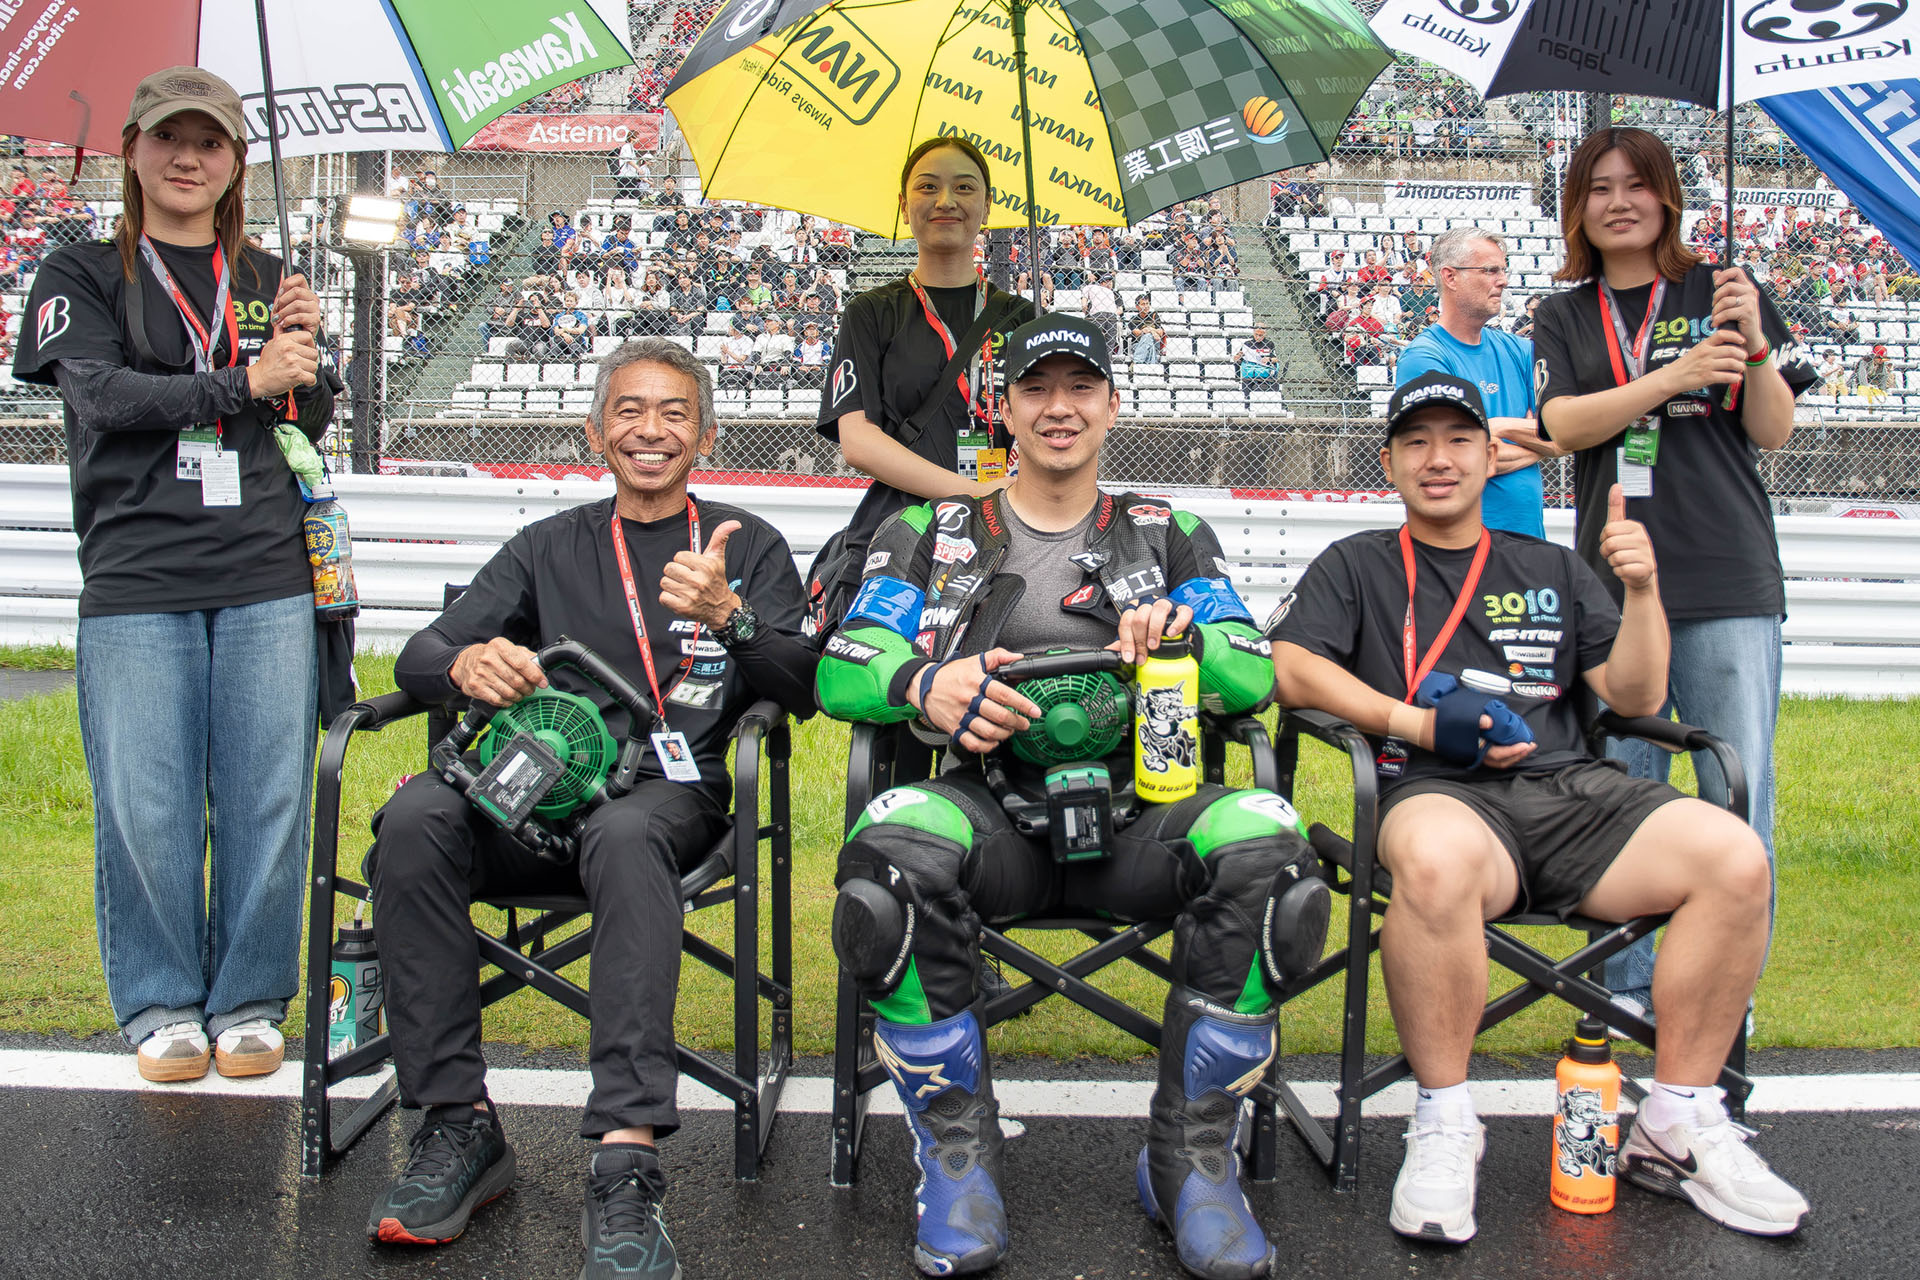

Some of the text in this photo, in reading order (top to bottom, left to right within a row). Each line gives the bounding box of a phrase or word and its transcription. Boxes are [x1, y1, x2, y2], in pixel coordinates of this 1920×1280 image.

[526, 122, 632, 145] Astemo
[1395, 181, 1522, 201] BRIDGESTONE
[1653, 316, 1689, 340] 30
[1025, 329, 1091, 351] NANKAI
[1402, 384, 1465, 406] NANKAI
[982, 498, 1004, 537] NANKAI
[1483, 587, 1560, 617] 30 10
[1488, 628, 1563, 642] RS-ITOH
[906, 902, 914, 933] PRODUCT
